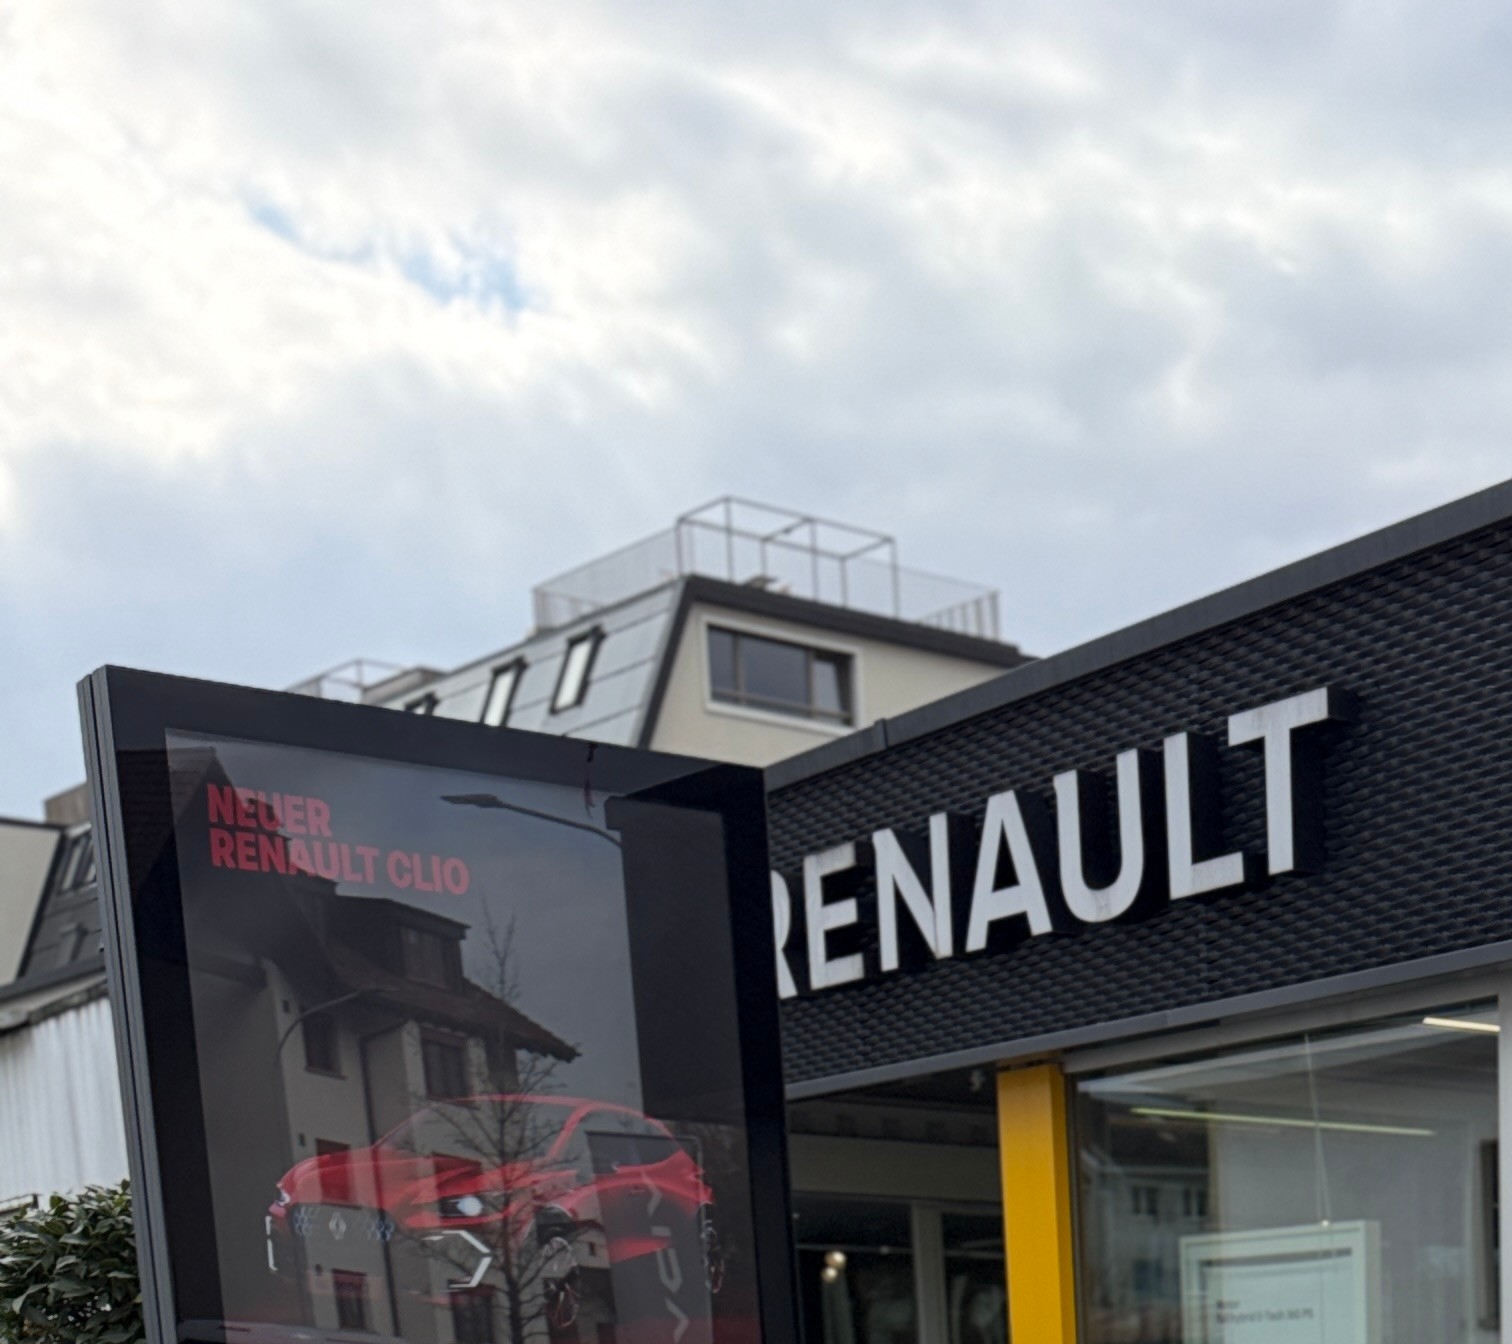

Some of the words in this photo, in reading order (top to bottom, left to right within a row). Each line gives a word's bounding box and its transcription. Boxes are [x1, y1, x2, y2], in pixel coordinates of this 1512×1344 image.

[206, 783, 333, 837] NEUER
[209, 827, 379, 884] RENAULT
[387, 849, 470, 896] CLIO
